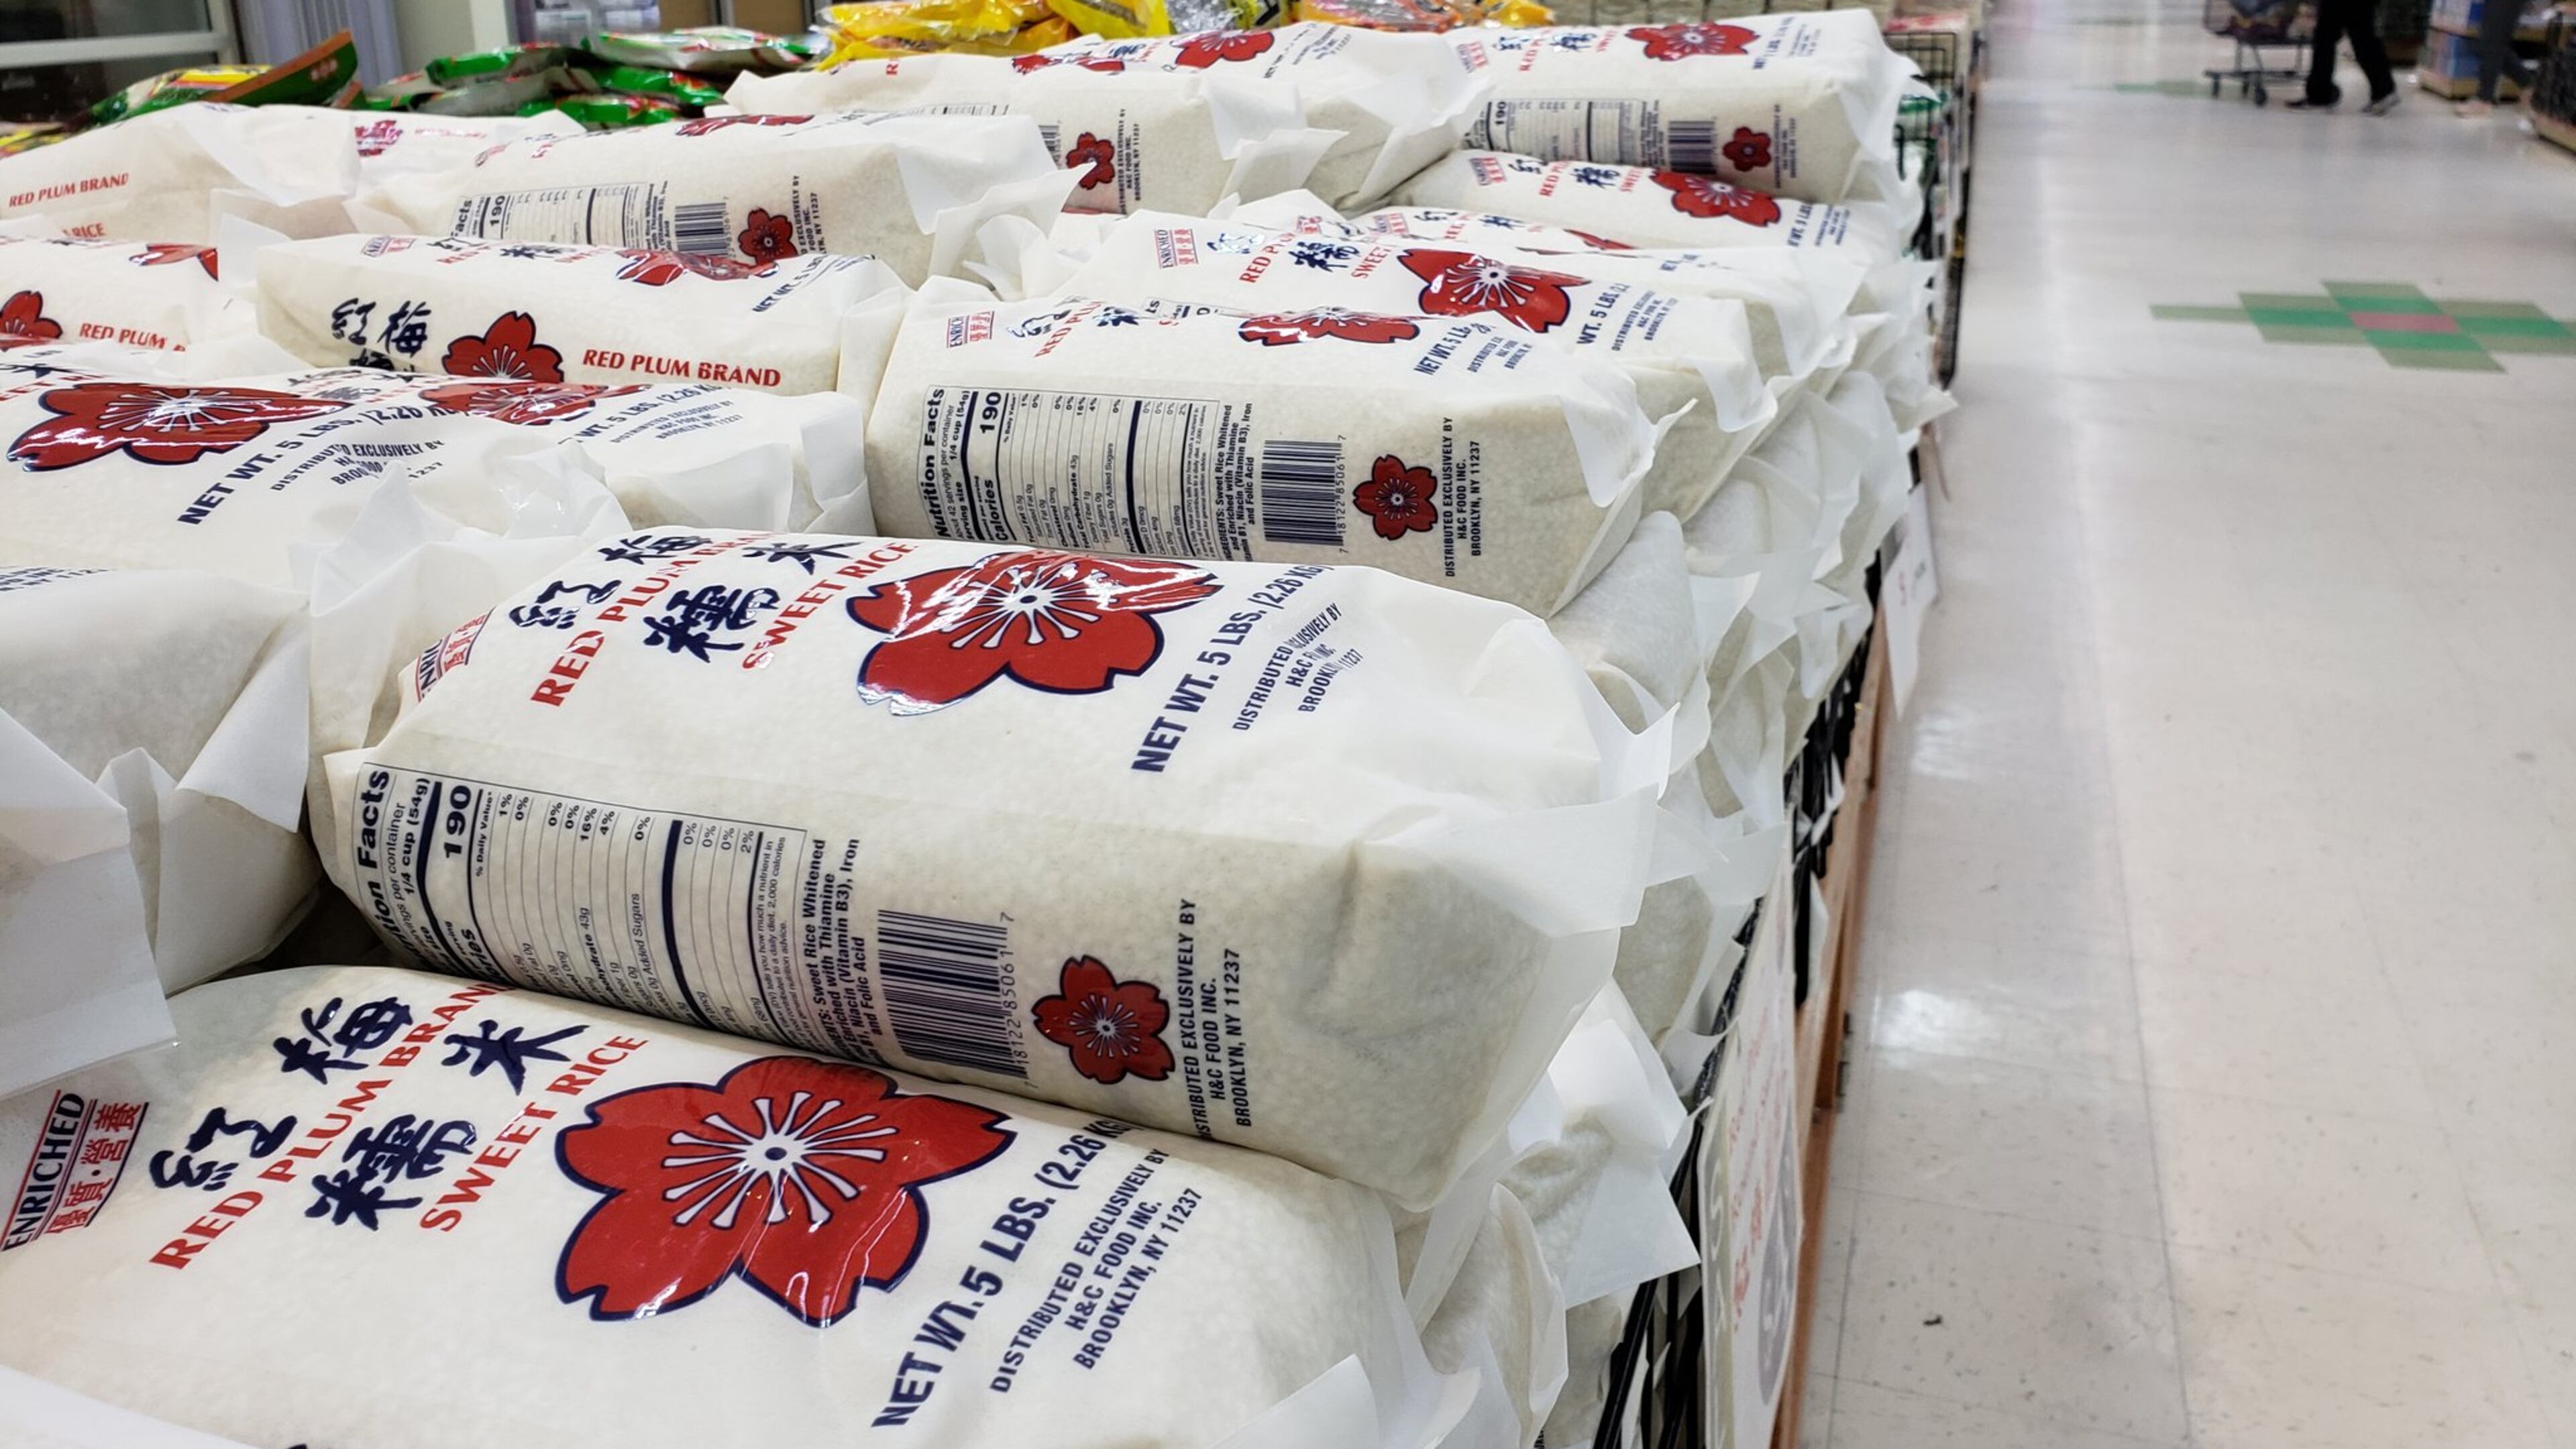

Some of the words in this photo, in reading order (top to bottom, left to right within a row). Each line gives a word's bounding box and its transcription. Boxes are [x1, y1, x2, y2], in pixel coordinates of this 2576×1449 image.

[9, 193, 34, 207] RED
[38, 183, 76, 201] PLUM
[80, 173, 129, 193] BRAND
[792, 175, 800, 186] BY
[490, 196, 505, 226] 190
[792, 190, 805, 248] EXCLUSIVELY
[810, 193, 822, 219] 11237
[805, 228, 816, 251] FOOD
[1239, 256, 1271, 282] RED
[80, 323, 114, 339] RED
[119, 329, 167, 349] PLUM
[1576, 323, 1602, 344] WT.
[1590, 309, 1607, 319] 5
[583, 349, 625, 370] RED
[630, 354, 691, 378] PLUM
[697, 362, 782, 387] BRAND
[1413, 356, 1443, 375] NET
[1428, 343, 1456, 360] WT.
[606, 415, 627, 423] 5
[924, 388, 945, 446] Facts
[955, 390, 971, 417] (54g)
[979, 392, 1002, 434] 190
[1242, 402, 1253, 423] Iron
[941, 405, 954, 450] container
[953, 421, 962, 441] cup
[1217, 405, 1233, 449] Whitened
[1238, 424, 1253, 450] B3),
[1443, 417, 1453, 431] BY
[352, 443, 423, 458] EXCLUSIVELY
[425, 440, 445, 451] BY
[941, 451, 950, 467] per
[950, 444, 958, 461] 1/4
[1215, 451, 1225, 474] Rice
[1226, 421, 1240, 470] Thiamine
[1470, 441, 1480, 474] 11237
[176, 482, 235, 525] NET
[225, 453, 284, 480] WT.
[275, 440, 303, 449] 5
[297, 418, 362, 438] LBS.
[1224, 471, 1234, 494] with
[1234, 452, 1246, 494] (Vitamin
[1244, 457, 1254, 481] Acid
[1336, 455, 1346, 497] 85061
[1442, 436, 1454, 506] EXCLUSIVELY
[1456, 458, 1466, 482] INC.
[1470, 479, 1481, 494] NY
[921, 454, 951, 537] Nutrition
[1215, 475, 1225, 506] Sweet
[1235, 495, 1246, 521] Niacin
[1245, 483, 1255, 508] Folic
[1456, 487, 1467, 515] FOOD
[984, 479, 1008, 541] Calories
[1225, 495, 1236, 535] Enriched
[1471, 496, 1483, 557] BROOKLYN,
[1443, 508, 1456, 577] DISTRIBUTED
[1456, 517, 1467, 539] H&C
[741, 579, 847, 669] SWEET
[836, 542, 918, 579] RICE
[1247, 574, 1305, 610] (2.26
[531, 630, 604, 706] RED
[597, 559, 701, 622] PLUM
[1210, 610, 1267, 645] LBS.
[1197, 650, 1232, 666] 5
[1232, 646, 1294, 731] DISTRIBUTED
[1326, 602, 1342, 621] BY
[1285, 659, 1313, 688] H&C
[1164, 674, 1220, 712] WT.
[1132, 716, 1187, 773] NET
[357, 770, 390, 869] Facts
[408, 777, 431, 827] (54g)
[498, 793, 513, 817] 1%
[515, 796, 530, 821] 0%
[548, 802, 563, 826] 0%
[565, 804, 580, 830] 0%
[386, 802, 407, 874] container
[443, 785, 472, 859] 190
[580, 807, 598, 841] 16%
[599, 810, 615, 836] 4%
[634, 816, 651, 841] 0%
[682, 822, 698, 845] 0%
[702, 825, 716, 848] 0%
[401, 830, 417, 866] cup
[476, 832, 488, 863] Daily
[840, 839, 860, 872] Iron
[400, 872, 415, 894] 1/4
[802, 839, 826, 918] Whitened
[835, 878, 854, 912] B3),
[580, 908, 591, 930] 43g
[631, 893, 644, 937] Sugars
[818, 873, 835, 950] Thiamine
[1000, 911, 1015, 923] 7
[1179, 898, 1196, 925] BY
[637, 940, 652, 975] Added
[804, 924, 817, 958] Rice
[835, 916, 855, 985] (Vitamin
[851, 936, 867, 972] Acid
[806, 963, 826, 1005] Sweet
[820, 955, 838, 991] with
[1000, 950, 1018, 1010] 85061
[1224, 948, 1240, 1006] 11237
[844, 989, 865, 1029] Niacin
[857, 975, 876, 1010] Folic
[1177, 933, 1198, 1051] EXCLUSIVELY
[1200, 977, 1217, 1015] INC.
[1201, 1020, 1222, 1064] FOOD
[1225, 1013, 1242, 1036] NY
[1208, 1068, 1226, 1100] H&C
[1226, 1041, 1252, 1128] BROOKLYN,
[149, 1191, 264, 1269] RED
[257, 1079, 392, 1183] PLUM
[379, 983, 518, 1067] BRAN
[420, 1102, 557, 1232] SWEET
[546, 1036, 649, 1095] RICE
[1, 1093, 85, 1251] ENRICHED
[1034, 1135, 1107, 1190] (2.26
[980, 1197, 1057, 1262] LBS.
[959, 1265, 1003, 1296] 5
[990, 1261, 1083, 1393] DISTRIBUTED
[1074, 1165, 1155, 1256] EXCLUSIVELY
[1144, 1148, 1169, 1165] BY
[1065, 1285, 1104, 1330] H&C
[1094, 1232, 1137, 1279] FOOD
[1128, 1201, 1163, 1229] INC.
[1073, 1265, 1157, 1369] BROOKLYN,
[1141, 1234, 1169, 1261] NY
[1162, 1188, 1202, 1234] 11237
[914, 1301, 984, 1352] WT.
[871, 1351, 943, 1427] NET
